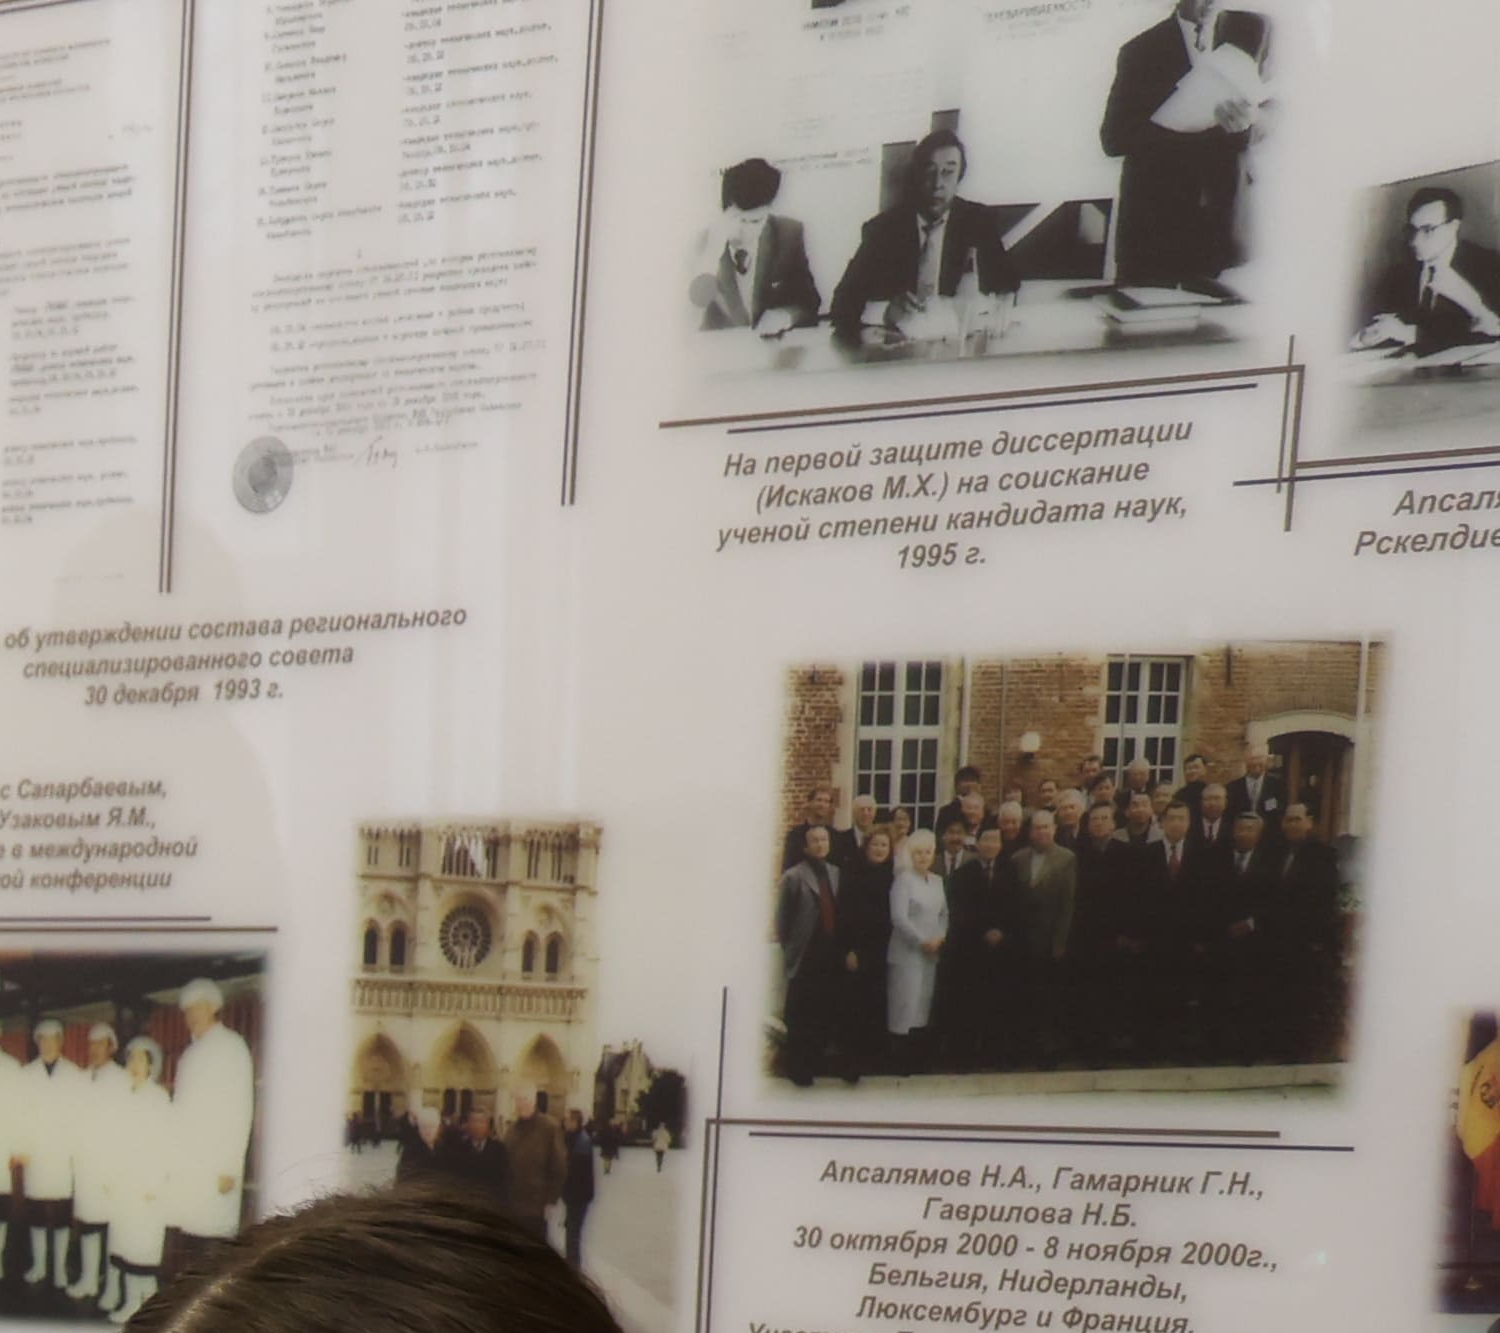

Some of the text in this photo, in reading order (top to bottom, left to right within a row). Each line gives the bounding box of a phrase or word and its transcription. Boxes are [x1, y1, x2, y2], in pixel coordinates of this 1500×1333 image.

[723, 421, 1194, 479] На первой защите диссертации
[756, 461, 1151, 516] (Искаков М.Х.) на соискание
[1392, 488, 1500, 516] Апсал
[715, 496, 1187, 553] ученой степени кандидата наук,
[898, 541, 986, 569] 1995 г.
[3, 626, 31, 651] об
[34, 620, 183, 654] утверждении
[187, 617, 284, 641] состава
[287, 607, 468, 641] регионального
[22, 646, 355, 680] специализированного совета
[84, 677, 284, 708] 30 декабря 1993 г.
[0, 784, 11, 801] с
[10, 843, 24, 861] в
[28, 835, 199, 865] международной
[29, 867, 173, 895] конференции
[819, 1159, 1264, 1201] Апсалямов Н.А., Гамарник Г.Н.,
[922, 1196, 1137, 1228] Гаврилова Н.Б.
[793, 1225, 824, 1249] 30
[829, 1229, 949, 1260] октября
[955, 1231, 1020, 1258] 2000
[1043, 1235, 1060, 1260] 8
[1065, 1237, 1173, 1270] ноября
[1179, 1240, 1278, 1273] 2000г.,
[867, 1261, 1188, 1305] Бельгия, Нидерланды,
[855, 1295, 1028, 1332] Люксембург
[1035, 1309, 1054, 1329] и
